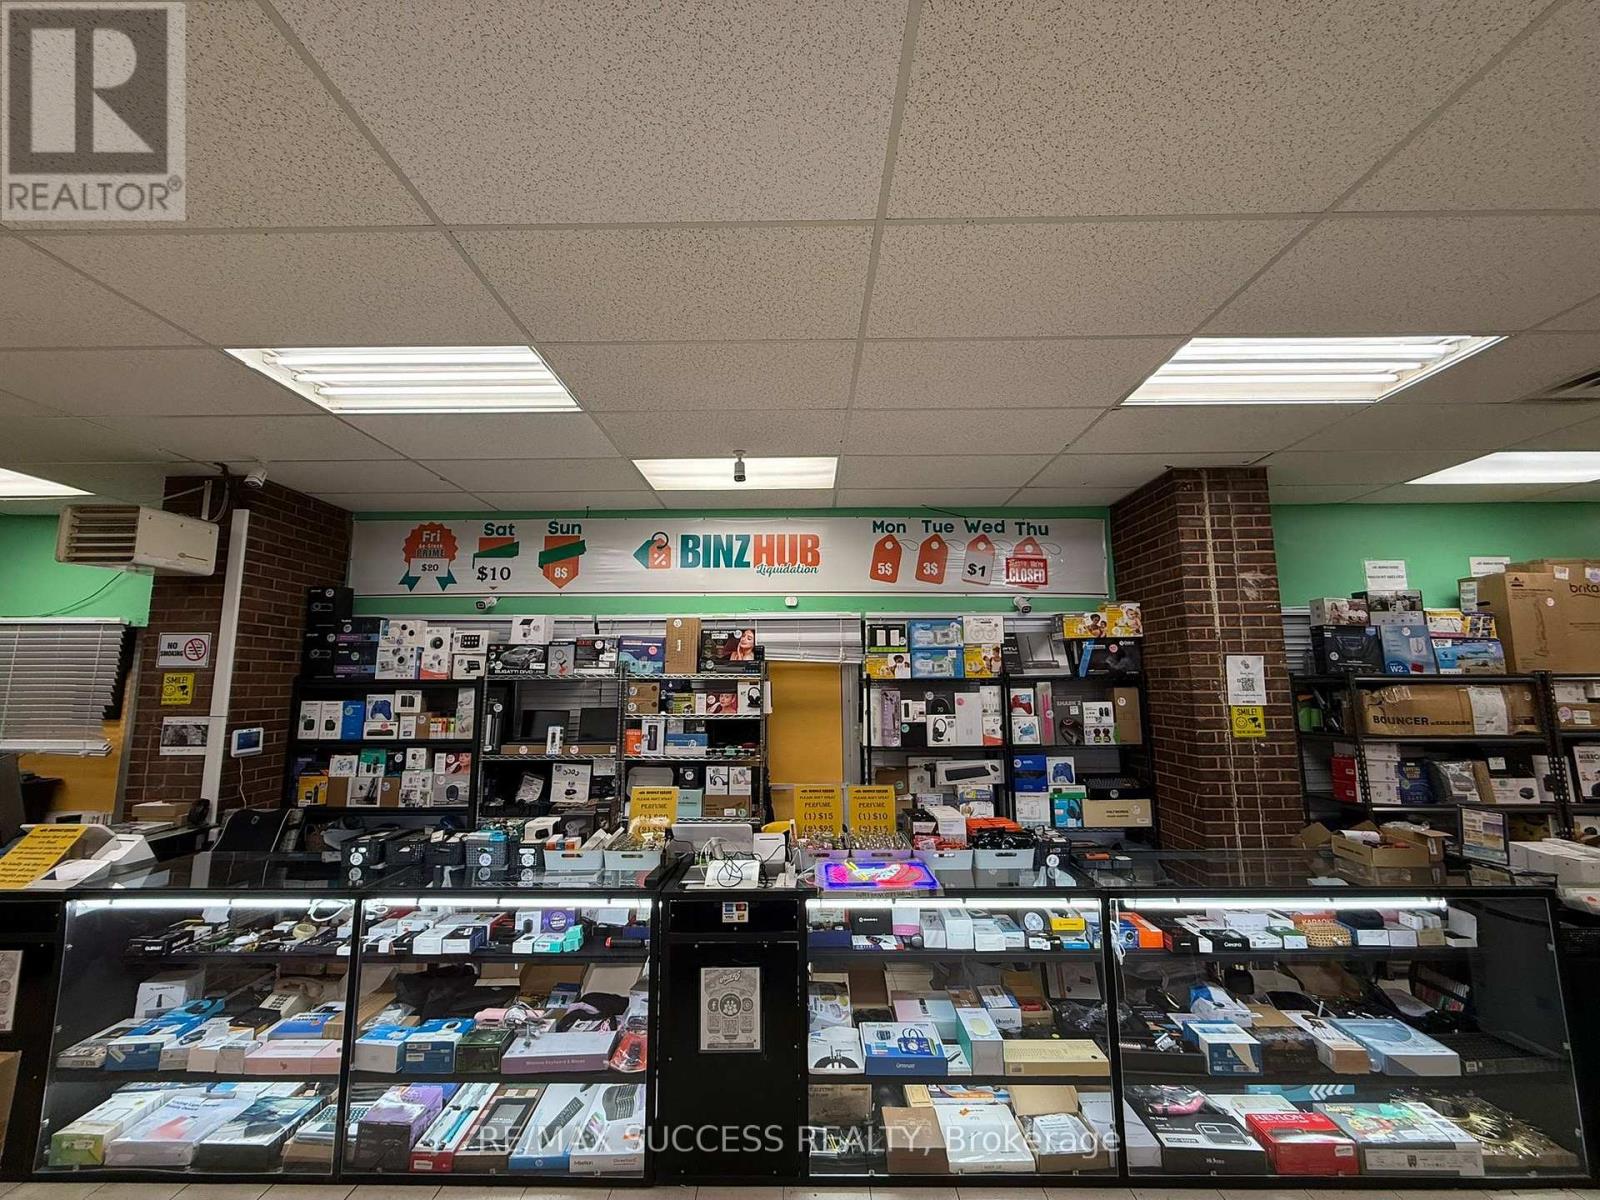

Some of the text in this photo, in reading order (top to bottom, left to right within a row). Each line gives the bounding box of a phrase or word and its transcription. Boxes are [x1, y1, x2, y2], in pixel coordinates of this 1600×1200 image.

[483, 522, 516, 537] Sat
[548, 520, 582, 535] Sun
[872, 519, 1049, 536] Mon Tue Wed Thu
[422, 530, 441, 542] Fri
[421, 563, 439, 572] $20
[477, 565, 512, 583] $10
[756, 563, 818, 577] Liquidation
[877, 562, 893, 576] 5$
[967, 563, 986, 577] $1
[1009, 568, 1046, 583] CLOSED
[167, 642, 178, 650] NO
[1236, 708, 1257, 716] SMILE!
[1373, 715, 1429, 726] BOUNCER
[804, 812, 834, 821] (1) $15
[858, 812, 888, 821] (1) $10
[1253, 1113, 1305, 1122] REVLON
